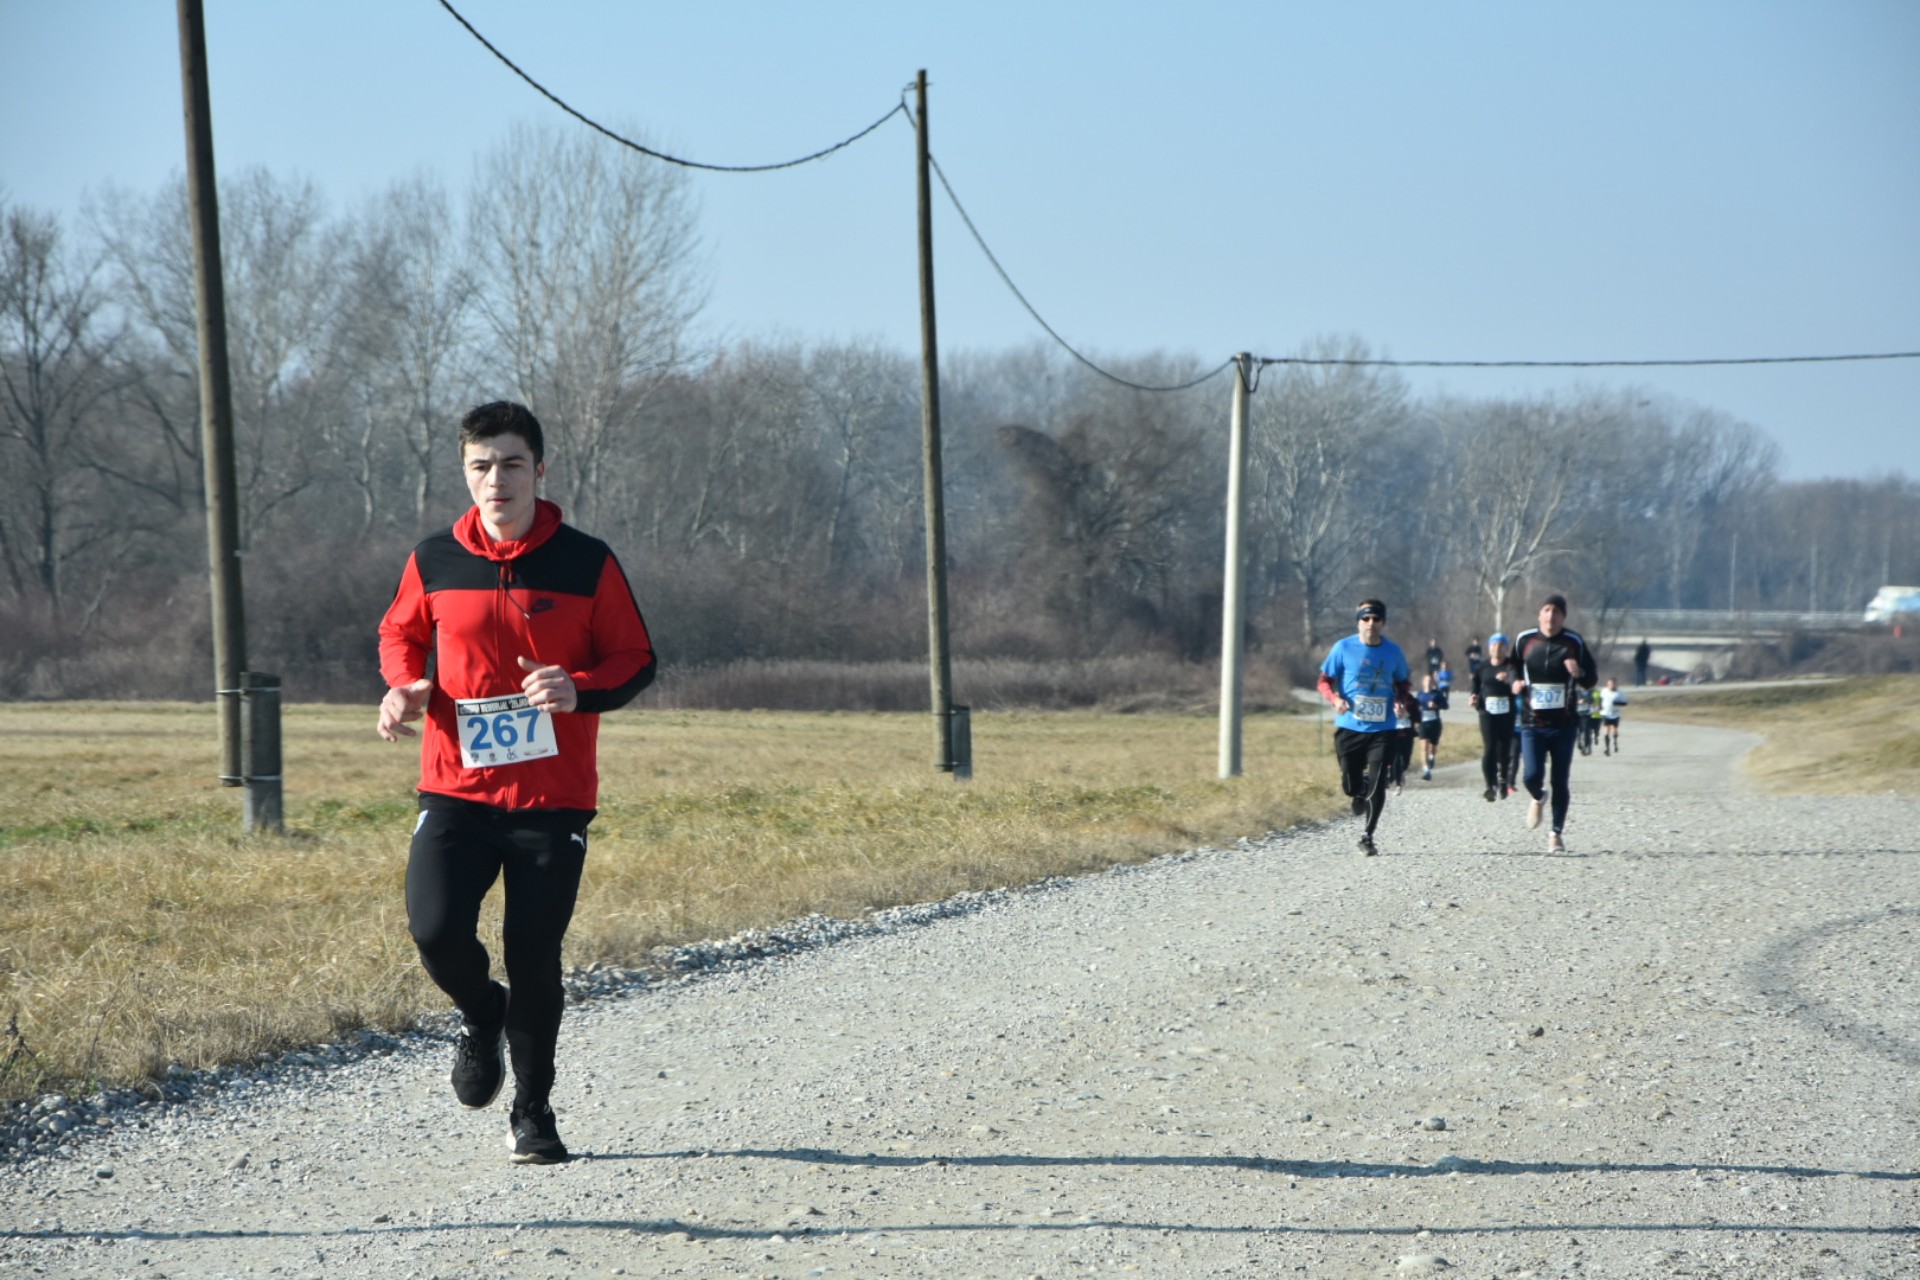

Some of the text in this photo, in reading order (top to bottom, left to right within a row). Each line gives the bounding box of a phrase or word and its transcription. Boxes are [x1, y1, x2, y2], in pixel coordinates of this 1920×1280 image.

[1535, 690, 1561, 703] 207
[1358, 702, 1384, 716] 230
[467, 708, 541, 750] 267
